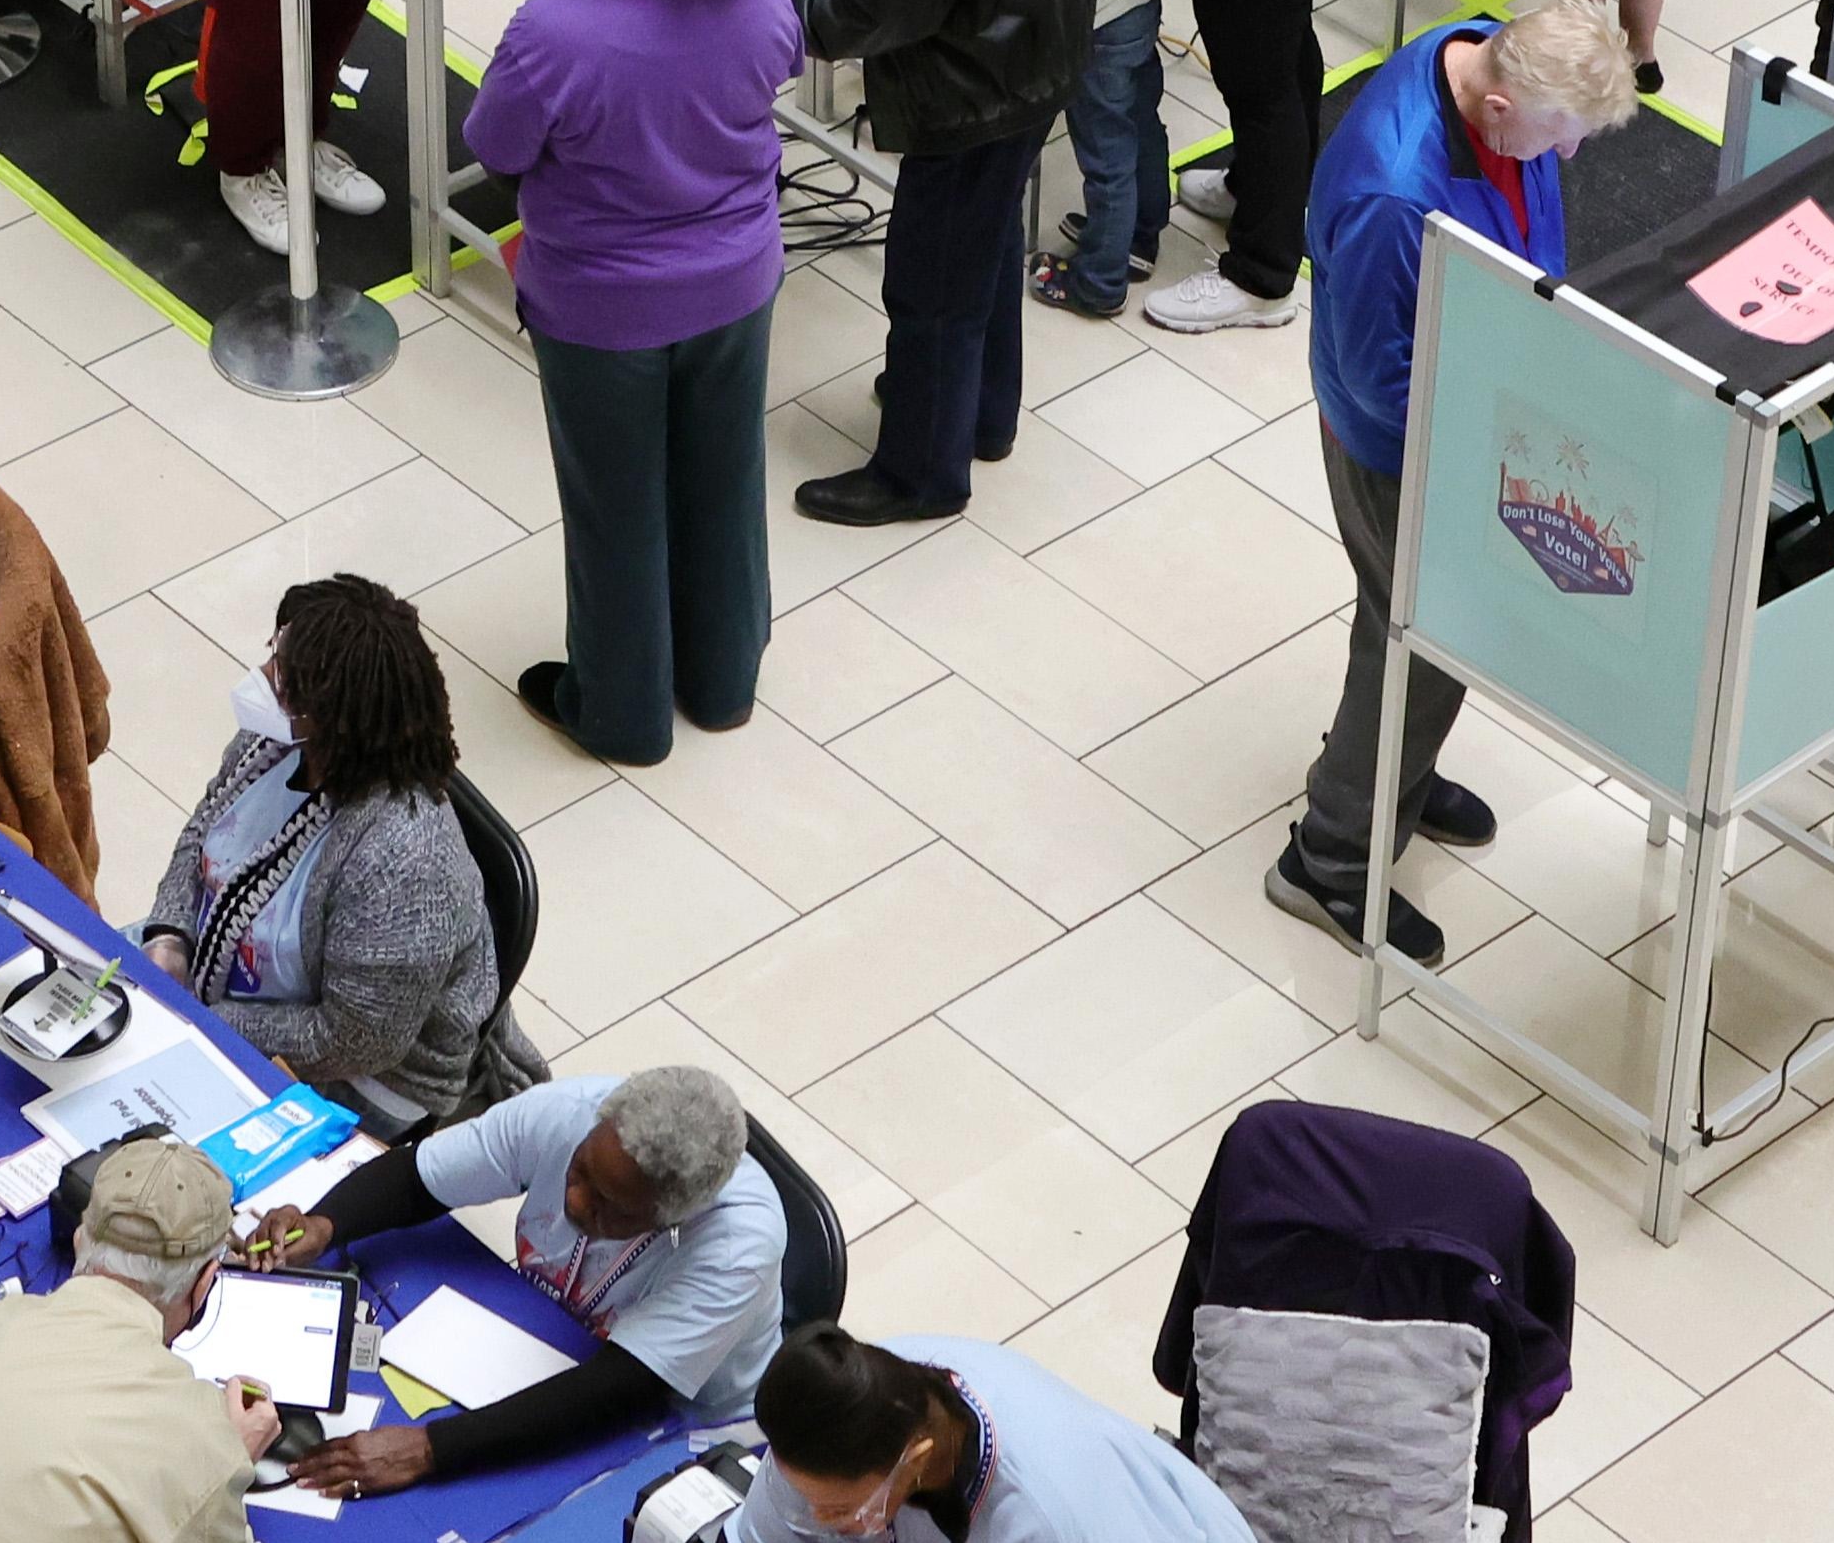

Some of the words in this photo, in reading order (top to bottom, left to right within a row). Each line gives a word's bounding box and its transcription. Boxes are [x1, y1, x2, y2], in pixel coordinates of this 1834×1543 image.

[1781, 262, 1816, 286] OUT
[1503, 503, 1536, 520] Don't
[1541, 510, 1565, 529] Lose
[1569, 521, 1596, 552] Your
[1599, 548, 1629, 588] Voice
[1544, 531, 1588, 570] Vote!
[109, 1095, 133, 1120] Pad
[131, 1080, 179, 1131] Operator
[127, 1115, 145, 1132] oll
